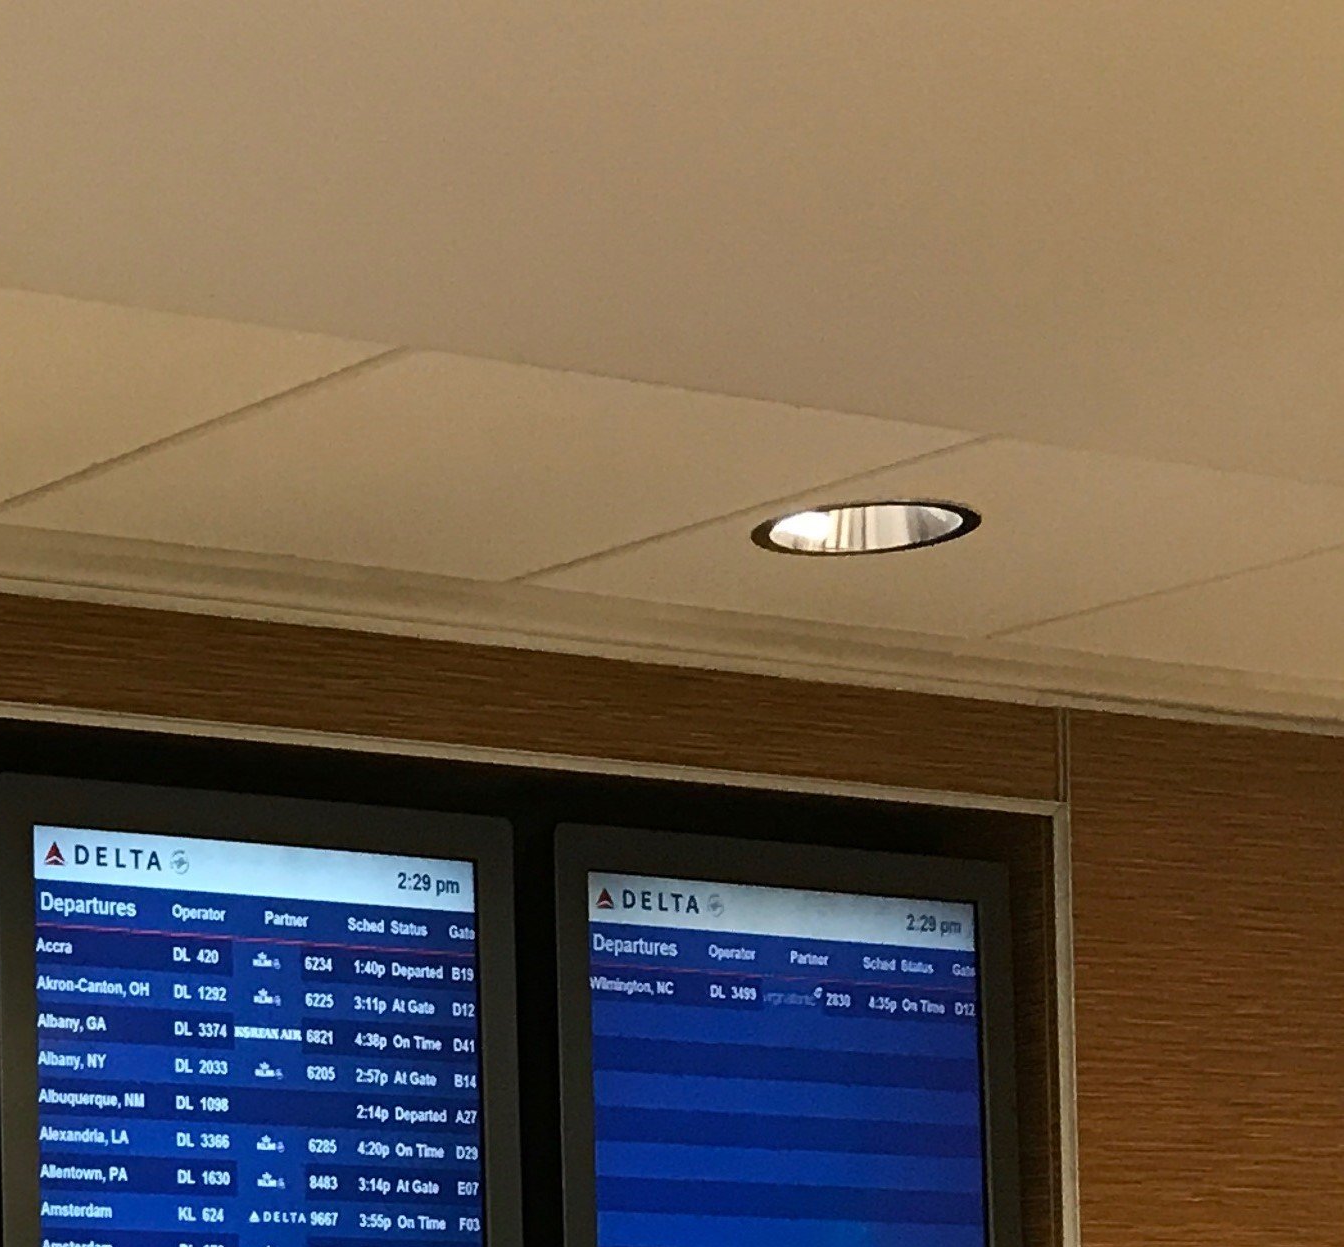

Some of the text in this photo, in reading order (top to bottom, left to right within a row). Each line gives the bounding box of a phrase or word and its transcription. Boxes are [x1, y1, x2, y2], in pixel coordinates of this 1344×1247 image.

[74, 844, 161, 870] DELTA
[397, 871, 459, 896] 2:29 pm
[40, 891, 136, 916] Departures
[171, 903, 225, 921] Operator
[264, 910, 308, 927] Partner
[347, 916, 384, 933] Sched
[390, 919, 428, 936] Status
[622, 888, 698, 914] DELTA
[905, 912, 962, 936] 2:29 pm
[35, 936, 443, 980] Accra DL Departed
[592, 933, 678, 956] Departures
[708, 944, 755, 960] Operator
[790, 950, 828, 965] Partner
[862, 956, 896, 970] Sched
[35, 975, 474, 1017] Akron-Canton, OH 3:11p D12
[656, 981, 673, 994] NC
[709, 984, 725, 998] DL
[901, 998, 918, 1011] On
[919, 999, 945, 1014] Time
[36, 1013, 474, 1052] Albany, GA 3374 D41
[37, 1050, 476, 1088] Albany, NY DL 2033 2:57p Gate B14
[38, 1087, 477, 1124] Albuquerque, NM 2:14p Departed A27
[38, 1125, 389, 1158] Alexandria, LA 4:20p
[39, 1163, 439, 1195] Allentown, PA DL 3:14p Gate
[40, 1201, 307, 1225] Amsterdam KL 624 DELTA
